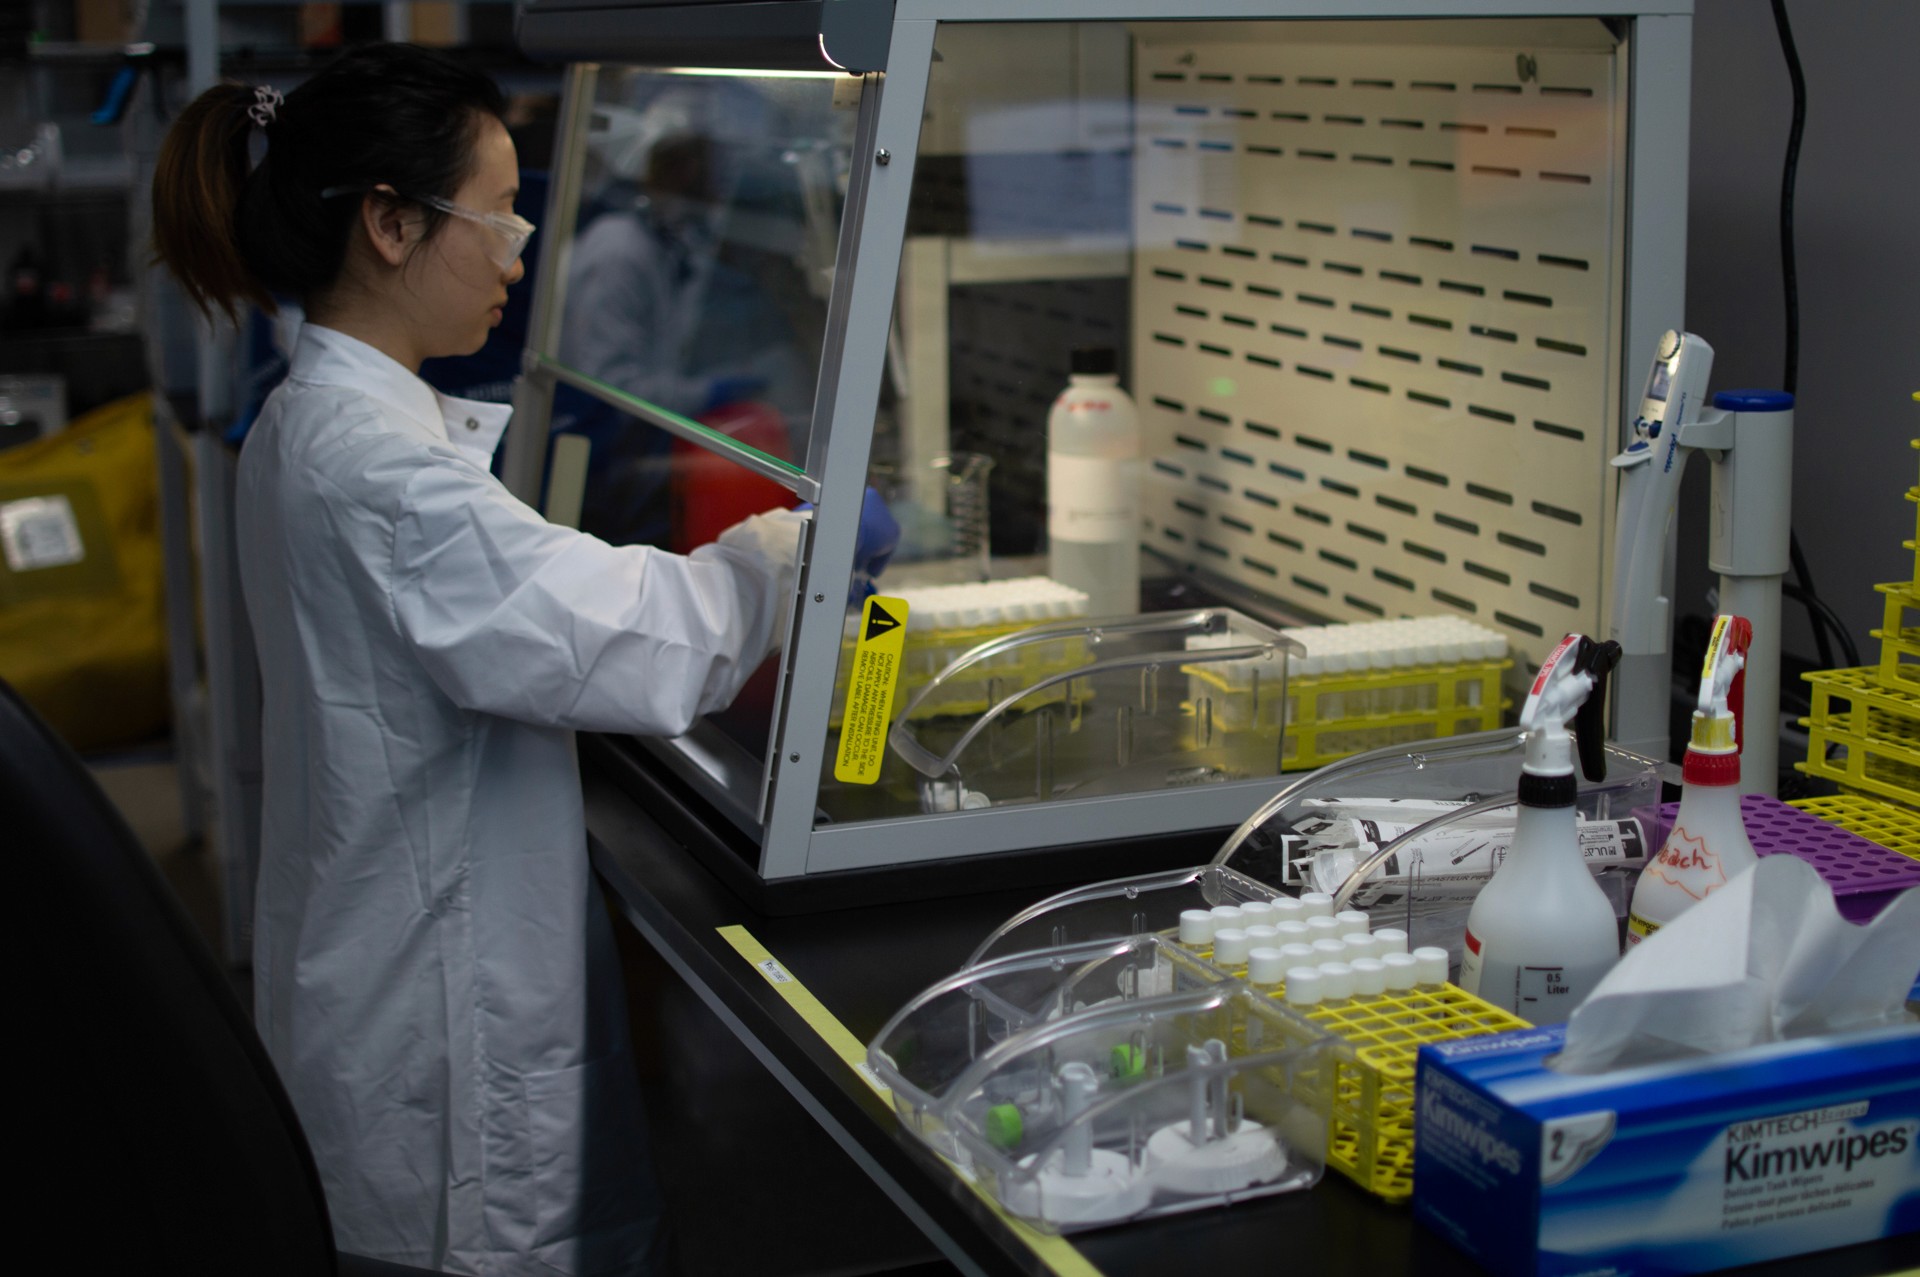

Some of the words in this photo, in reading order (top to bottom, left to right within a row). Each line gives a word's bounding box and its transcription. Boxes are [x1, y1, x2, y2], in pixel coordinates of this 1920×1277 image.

[858, 650, 869, 680] REMOVE
[877, 652, 886, 667] NOT
[873, 667, 882, 689] APPLY
[854, 681, 864, 700] LABEL
[861, 683, 872, 715] DAMAGE
[871, 688, 880, 703] ANY
[878, 690, 888, 713] WHEN
[850, 701, 860, 723] AFTER
[867, 703, 877, 736] PRESSURE
[857, 716, 866, 733] CAN
[842, 723, 856, 767] INSTALLATION
[862, 738, 870, 747] TO
[860, 748, 869, 760] THE
[867, 754, 876, 767] DO
[857, 761, 867, 776] SIDE
[1428, 874, 1470, 882] PASTEUR
[1547, 973, 1561, 983] 0.5
[1547, 985, 1570, 995] Liter
[1422, 1085, 1523, 1176] Kimwipes
[1726, 1112, 1819, 1144] KIMTECH
[1724, 1126, 1908, 1184] Kimwipes
[1724, 1185, 1764, 1200] Delicate
[1766, 1180, 1788, 1192] Task
[1790, 1174, 1824, 1188] Wipers
[1777, 1193, 1798, 1208] pour
[1753, 1211, 1775, 1226] para
[1775, 1206, 1805, 1221] tareas
[1807, 1198, 1852, 1214] delicadas
